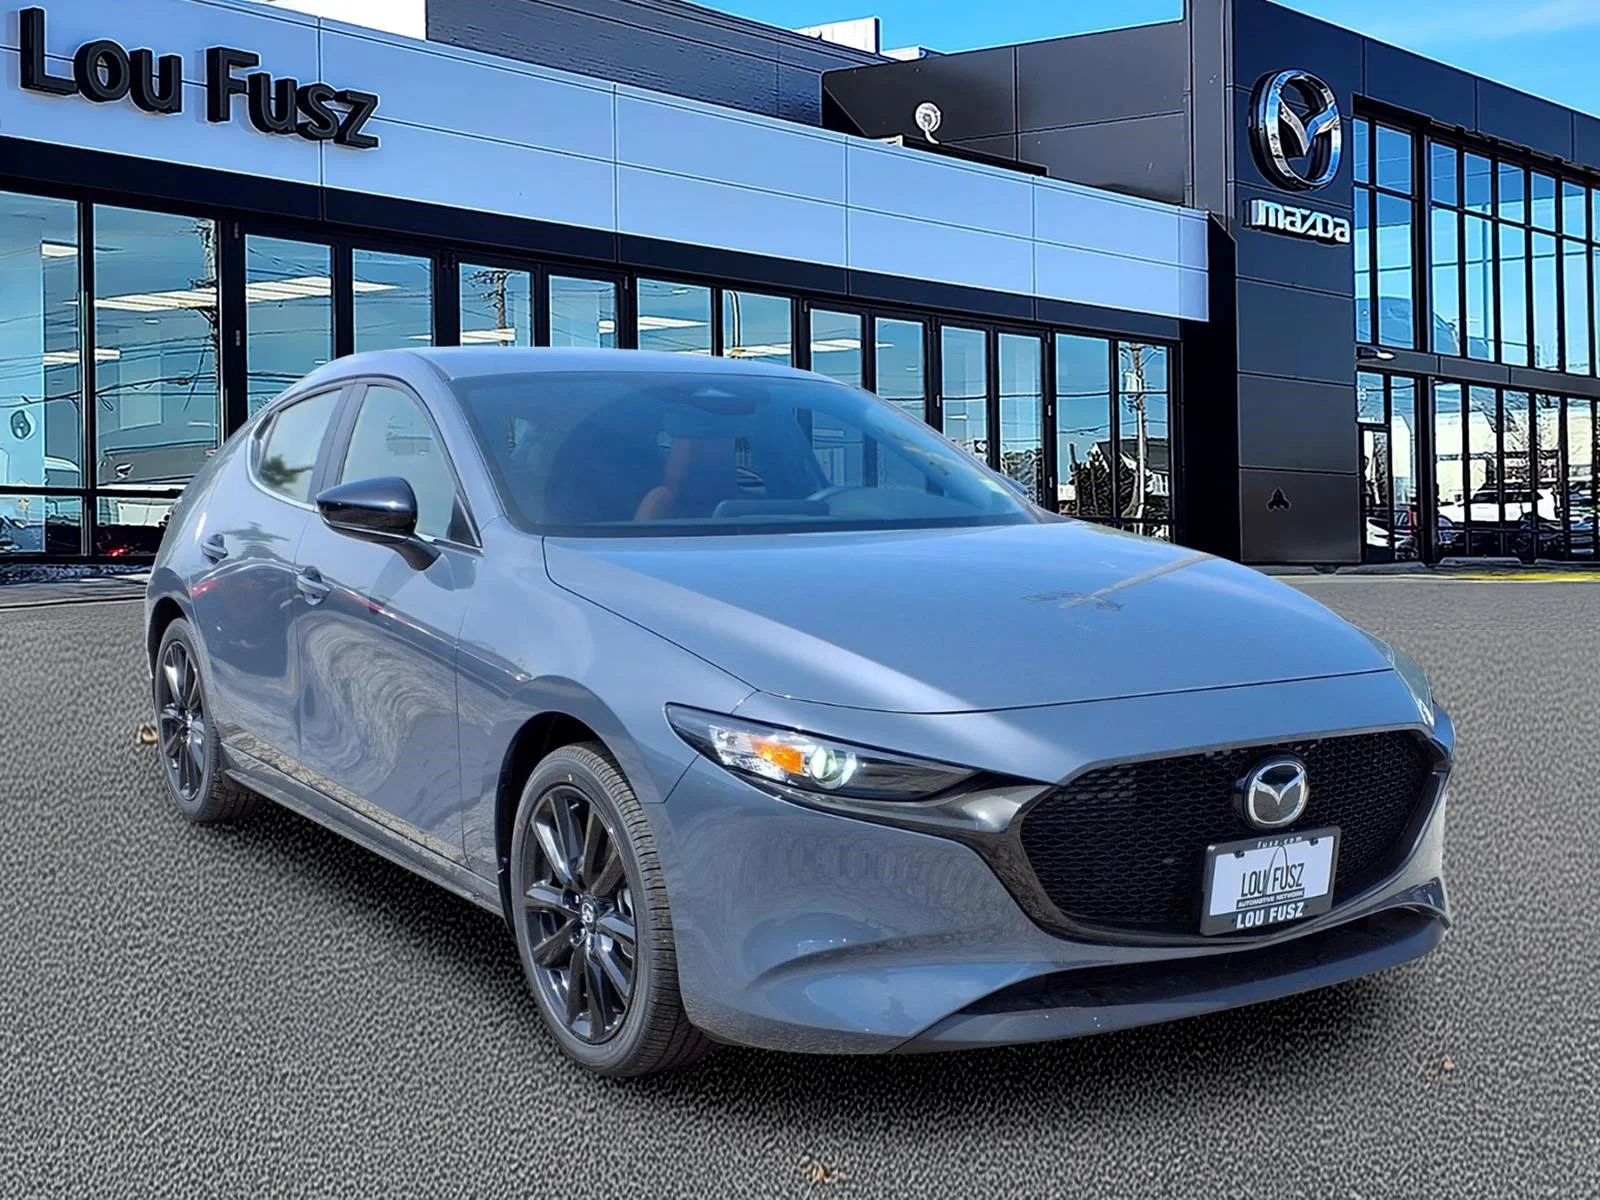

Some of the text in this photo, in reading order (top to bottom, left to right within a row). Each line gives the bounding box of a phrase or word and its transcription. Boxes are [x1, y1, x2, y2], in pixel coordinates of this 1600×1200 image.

[19, 7, 379, 149] Lou Fusz
[1240, 862, 1305, 898] LOU FUSZ
[1237, 891, 1304, 908] AUTOMOTIVE NETWORK
[1236, 902, 1305, 929] LOU FUSZ
